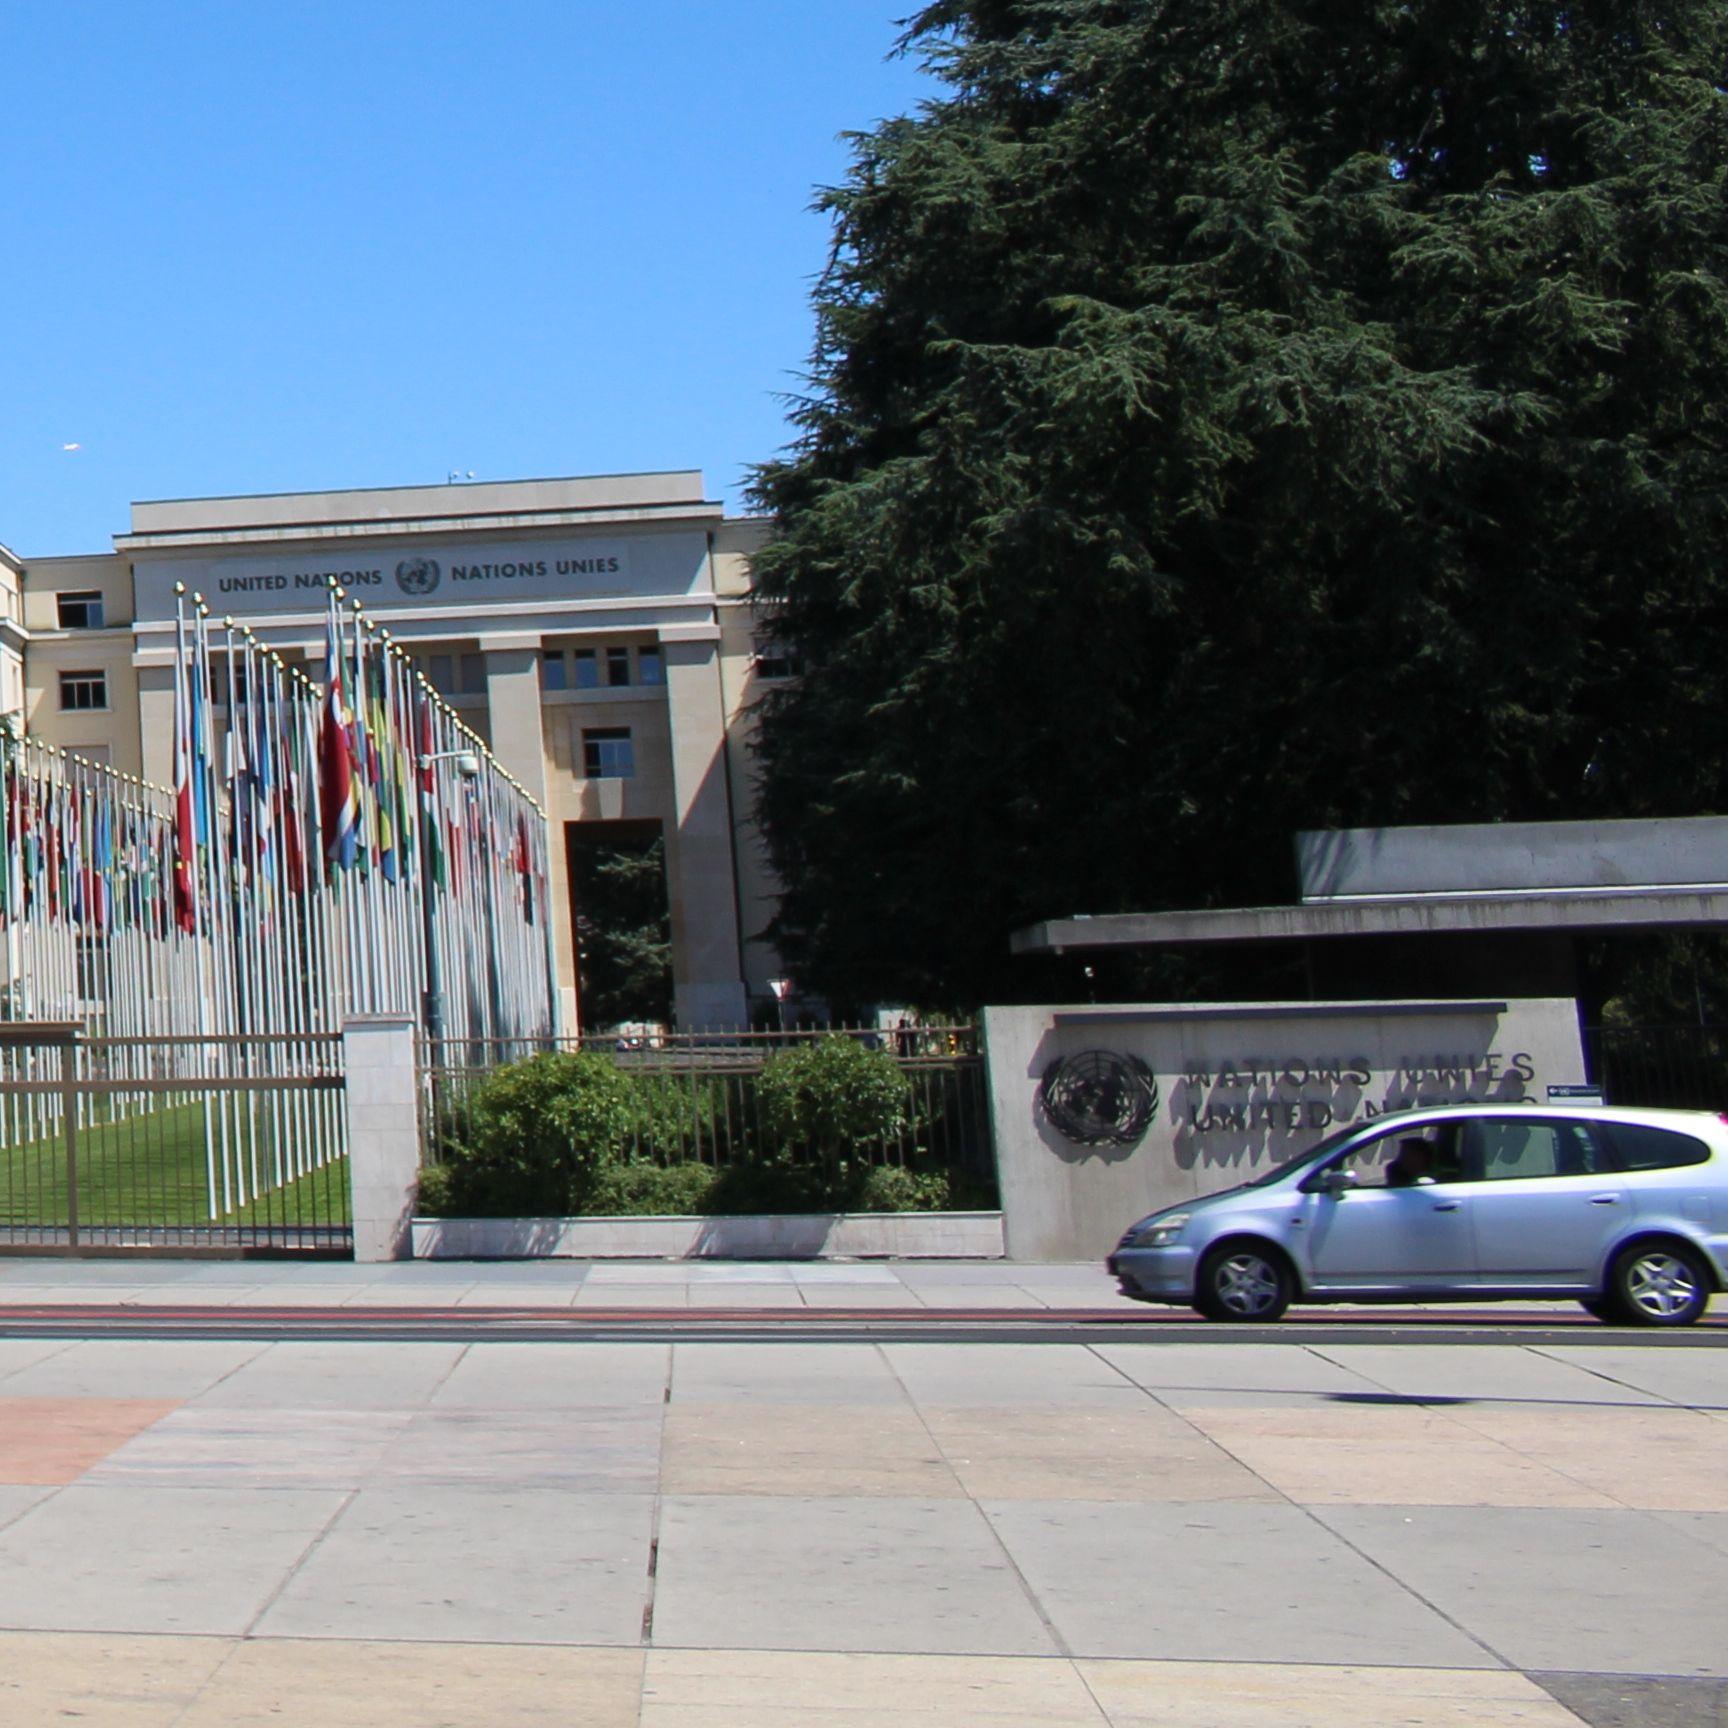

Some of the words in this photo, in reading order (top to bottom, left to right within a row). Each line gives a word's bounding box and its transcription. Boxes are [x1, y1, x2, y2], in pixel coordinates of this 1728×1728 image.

[451, 561, 547, 581] NATIONS
[556, 557, 619, 575] UNIES
[219, 576, 287, 592] UNITED
[1185, 1056, 1372, 1088] NATIONS
[1398, 1052, 1536, 1085] UNIES
[1192, 1098, 1332, 1133] UNITED
